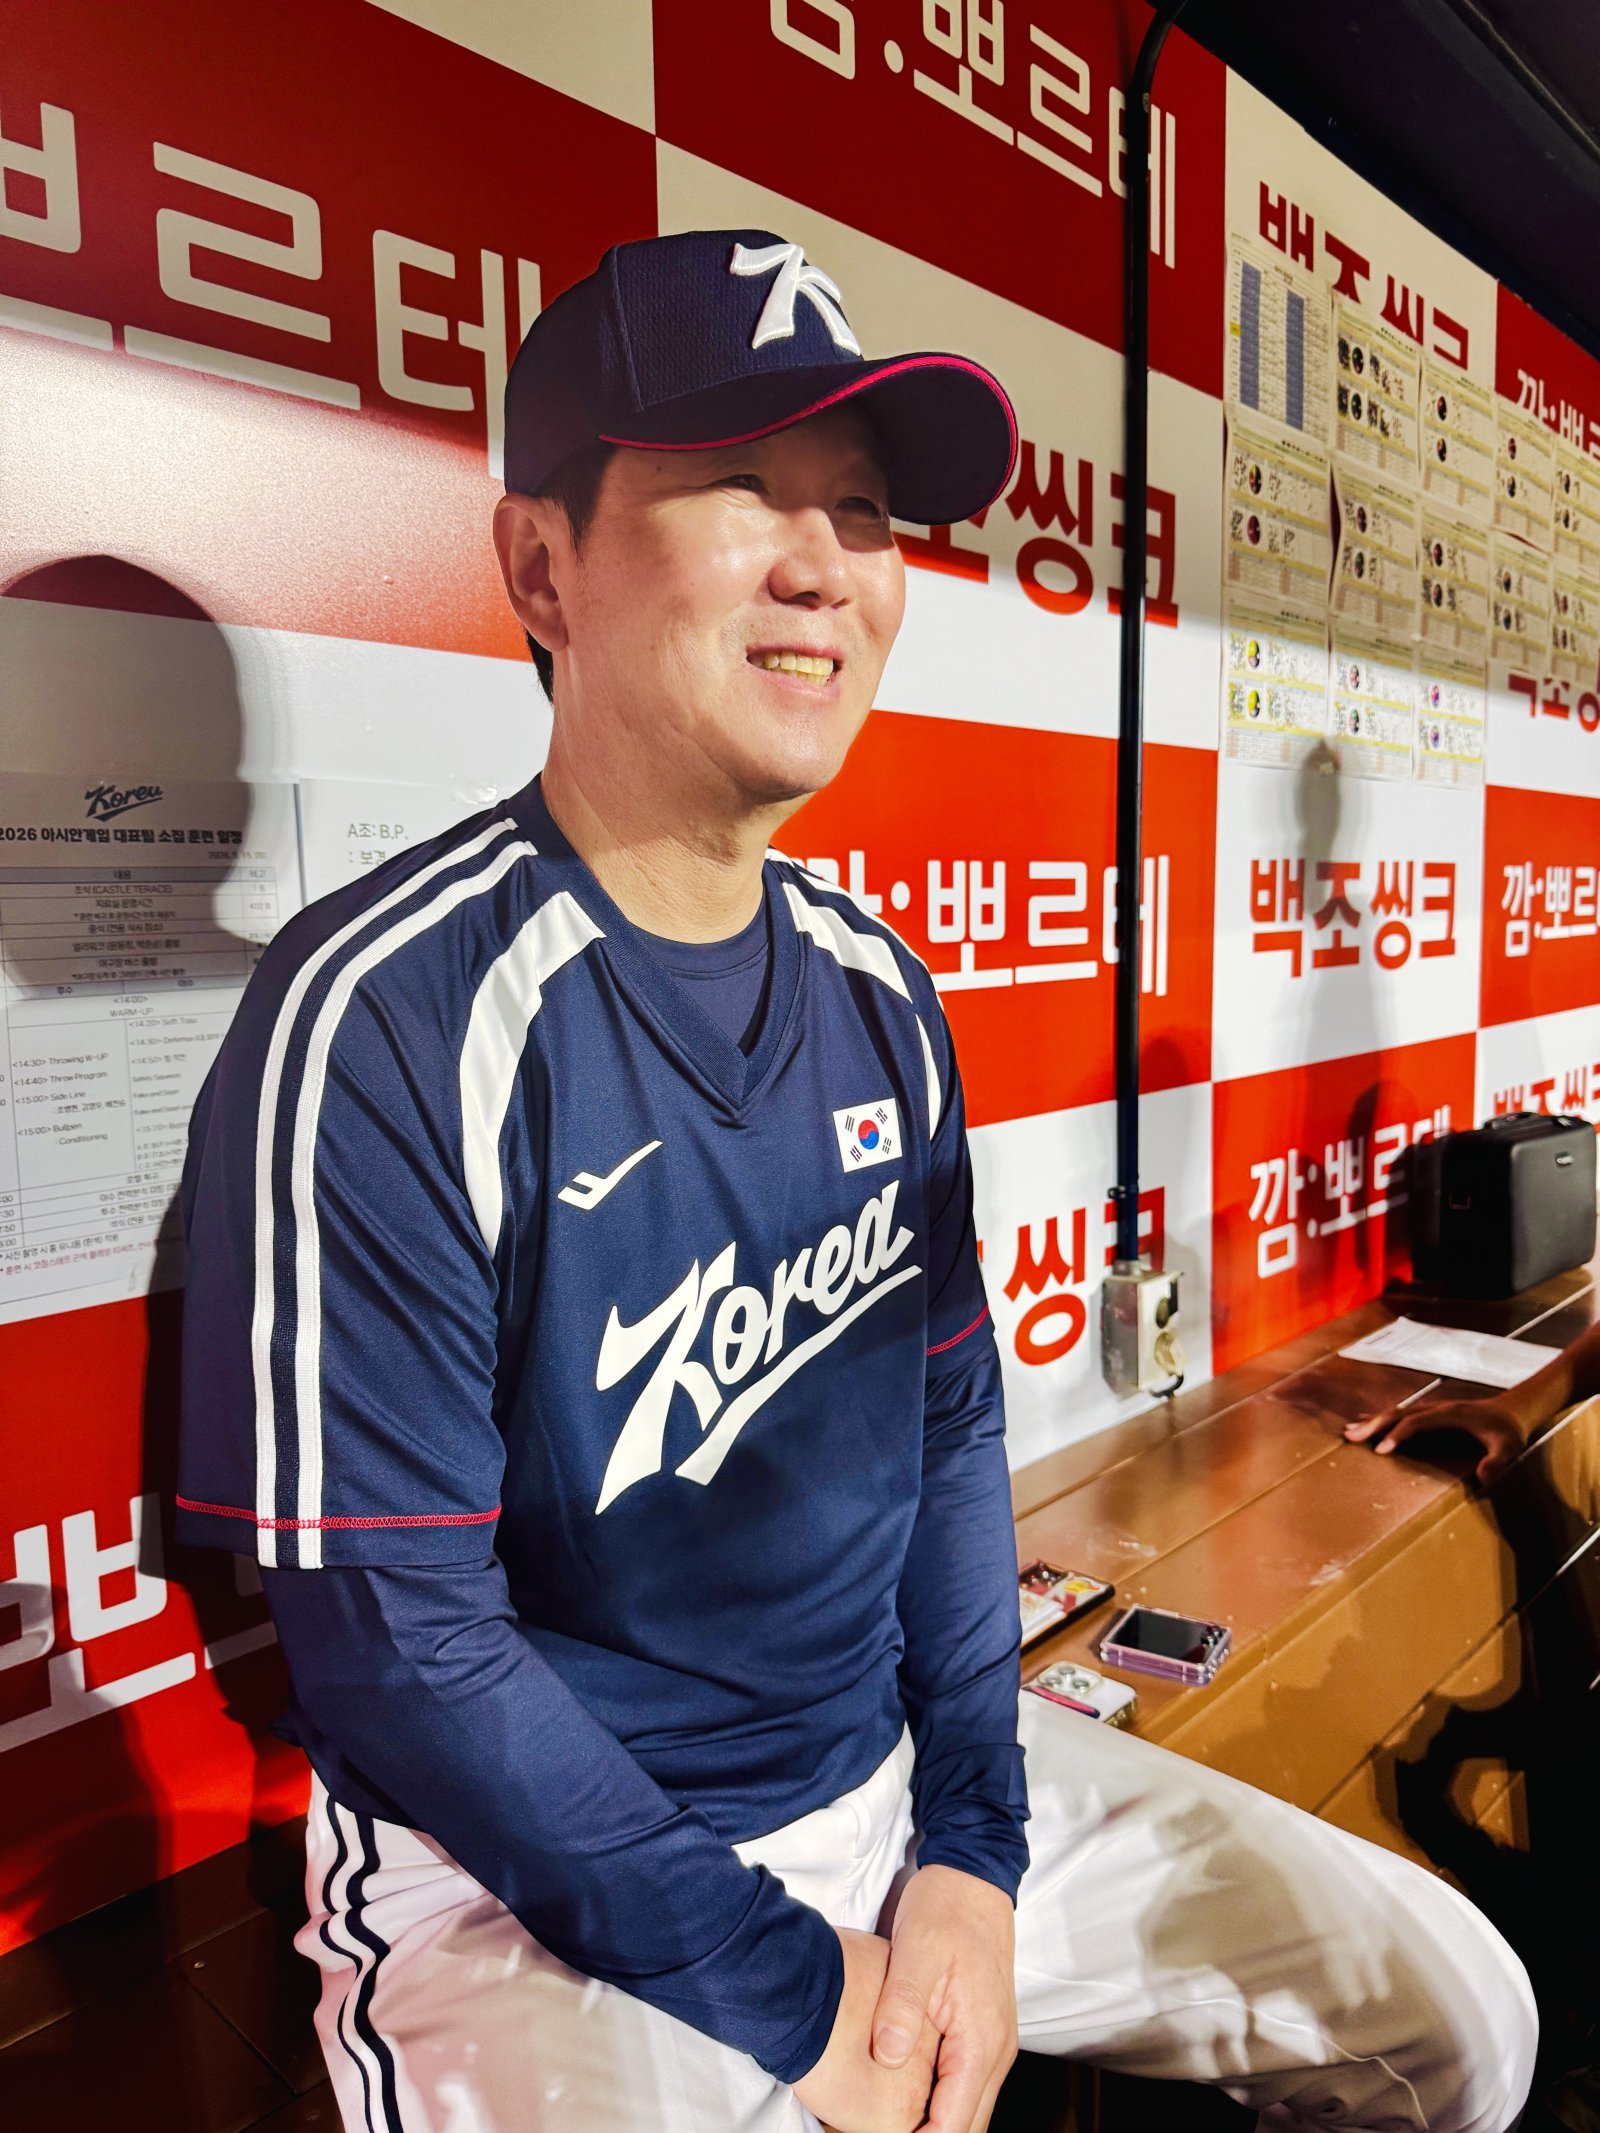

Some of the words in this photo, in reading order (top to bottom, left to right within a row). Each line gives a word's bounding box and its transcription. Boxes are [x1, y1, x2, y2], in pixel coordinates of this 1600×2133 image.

[85, 784, 163, 822] Korea
[0, 828, 37, 842] 2026
[41, 828, 111, 844] 아시안게임
[113, 829, 154, 844] 대표팀
[158, 829, 186, 844] 소집
[217, 830, 243, 845] 일정
[347, 823, 377, 838] A조:
[1249, 857, 1456, 979] 백조씽크
[596, 1180, 922, 1515] Korea
